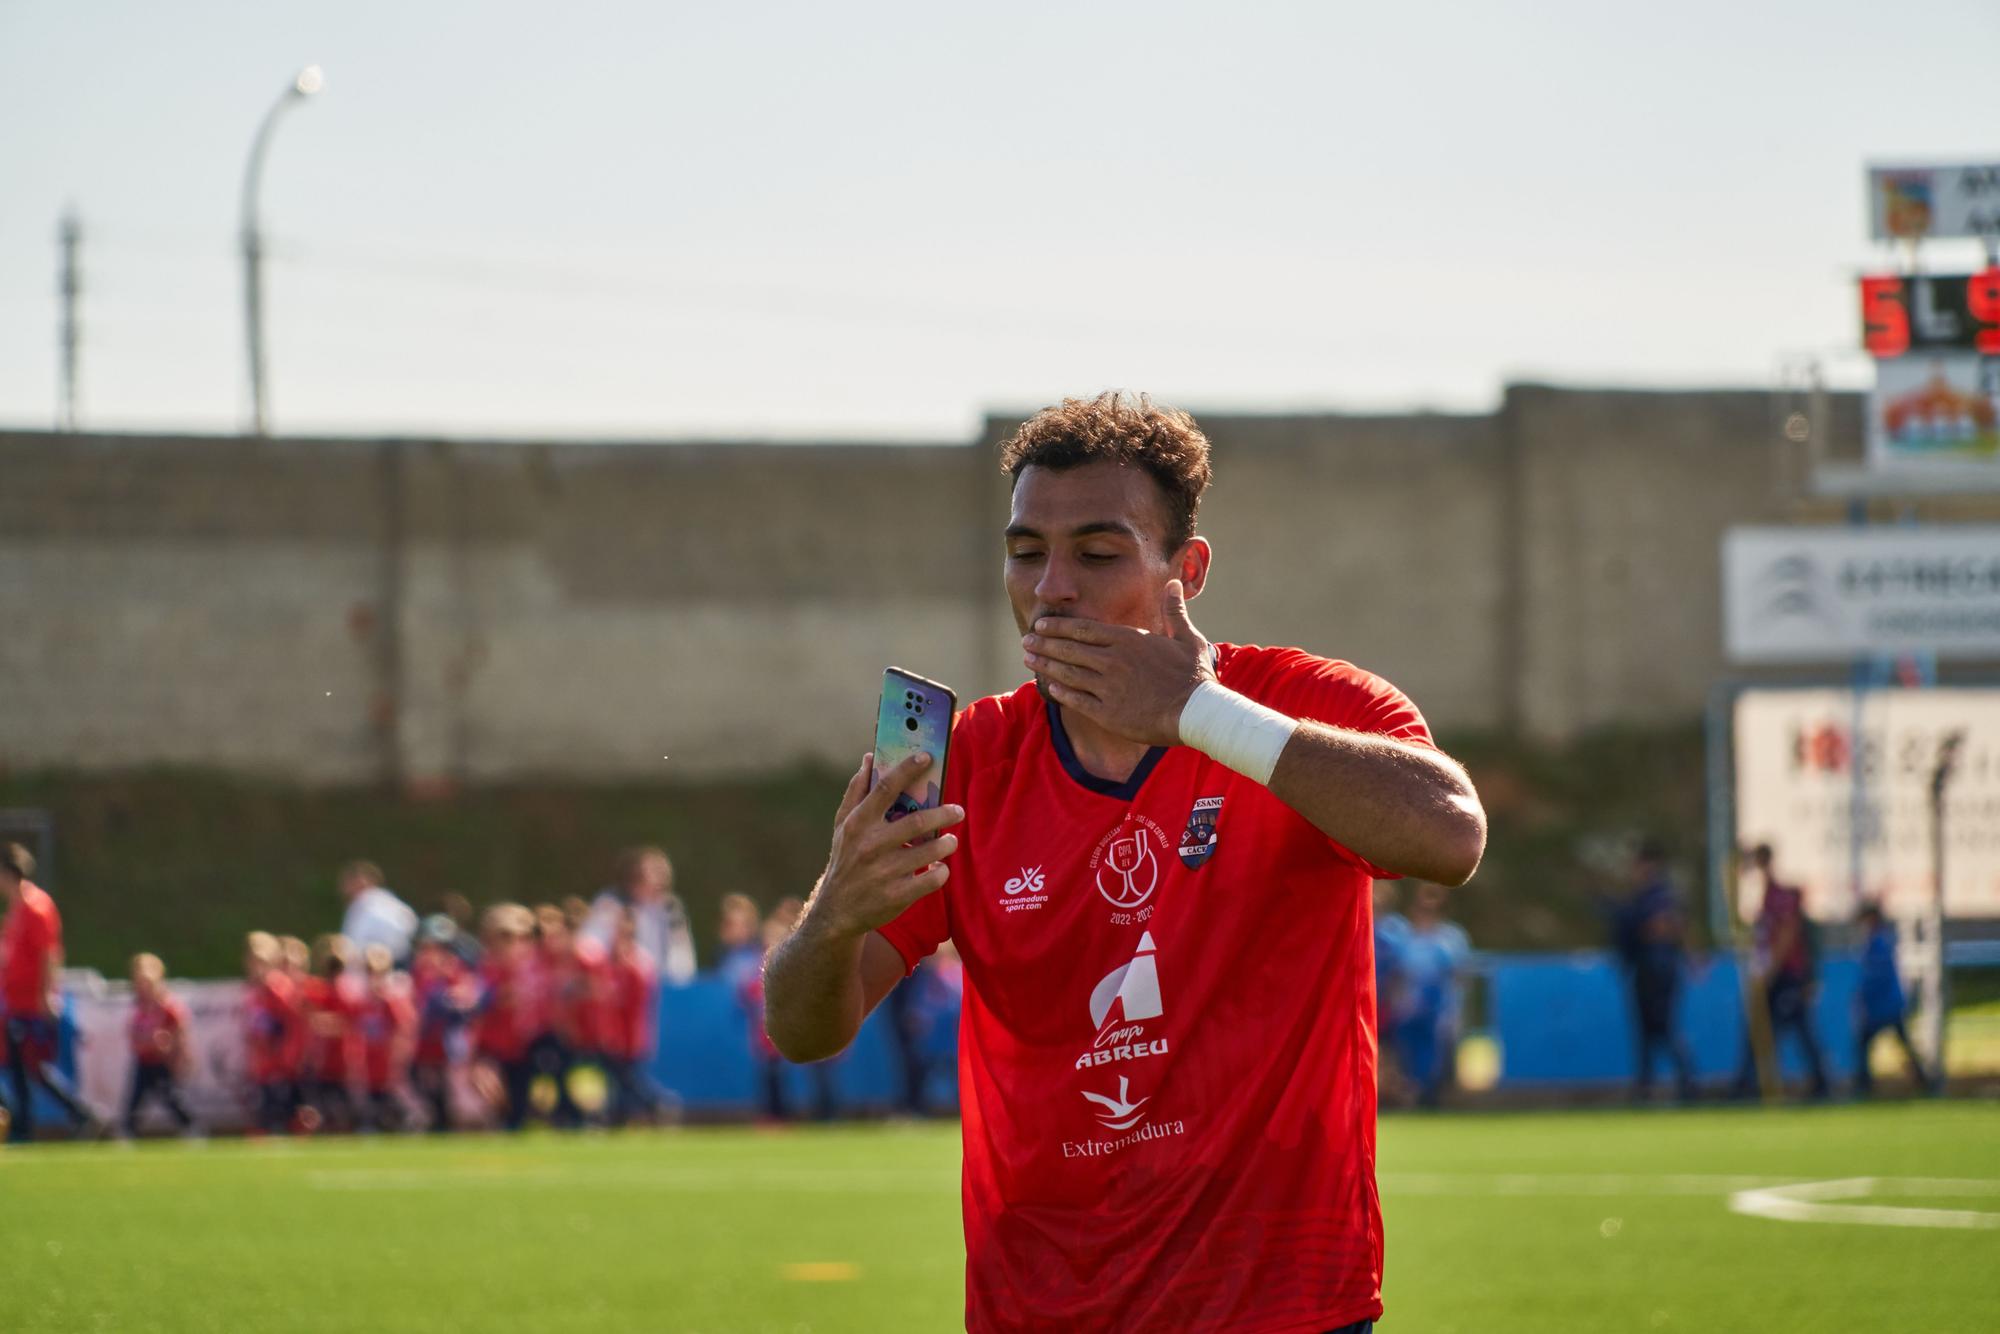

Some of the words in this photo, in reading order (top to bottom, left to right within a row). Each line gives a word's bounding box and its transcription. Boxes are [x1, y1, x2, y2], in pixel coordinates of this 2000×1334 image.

[1860, 273, 1911, 359] 5
[999, 895, 1048, 905] extremadura
[1006, 903, 1042, 913] sport.com
[1094, 1019, 1144, 1048] Grupo
[1075, 1038, 1169, 1070] ABREU
[1062, 1119, 1185, 1158] Extremadura
